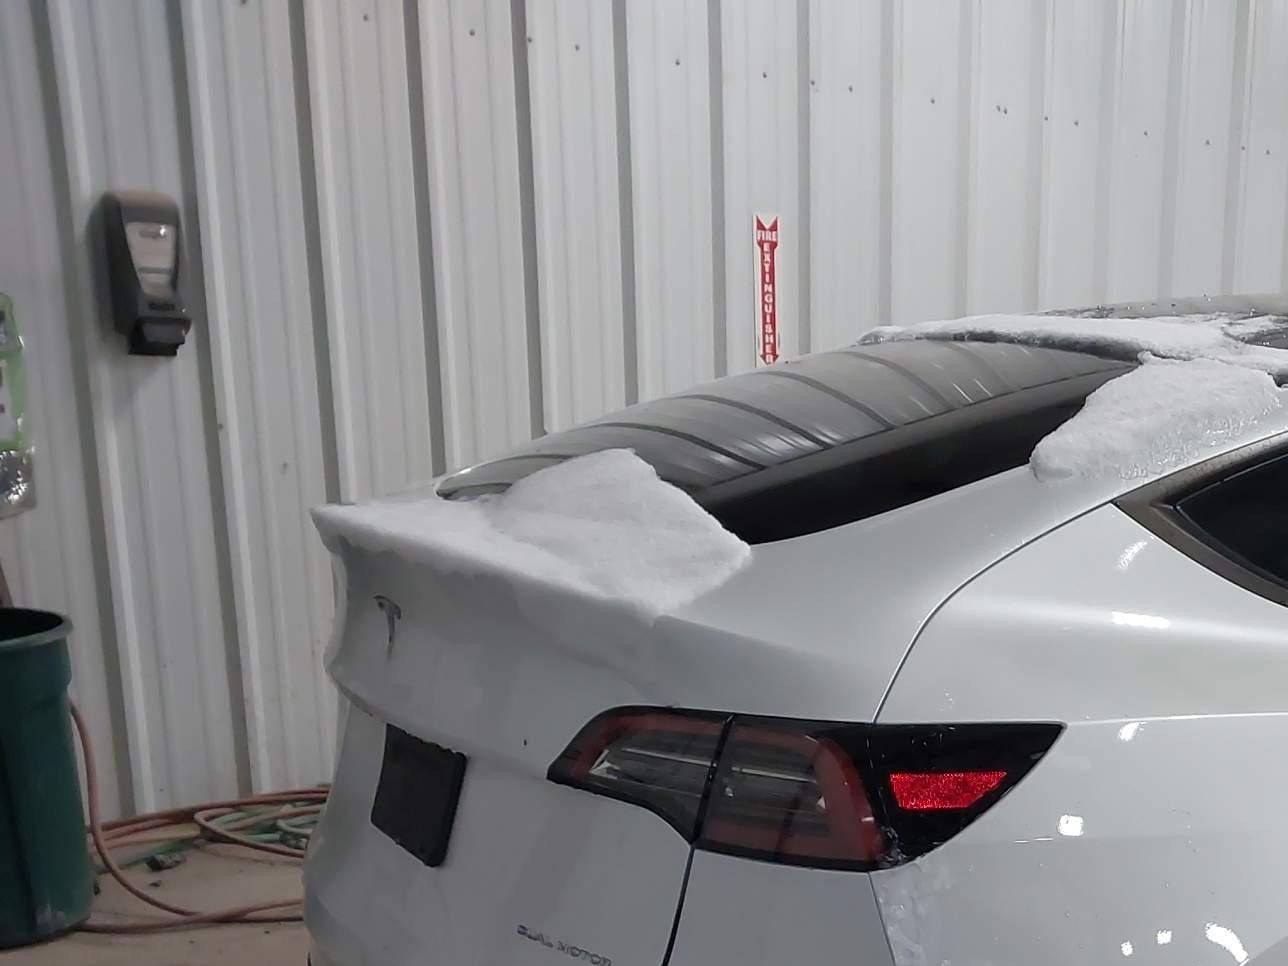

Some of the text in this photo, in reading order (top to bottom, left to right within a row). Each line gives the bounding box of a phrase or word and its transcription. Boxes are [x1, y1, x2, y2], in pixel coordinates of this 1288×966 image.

[757, 230, 777, 241] FIRE
[762, 242, 774, 363] EXTINGUISHER
[516, 924, 554, 948] DUAL
